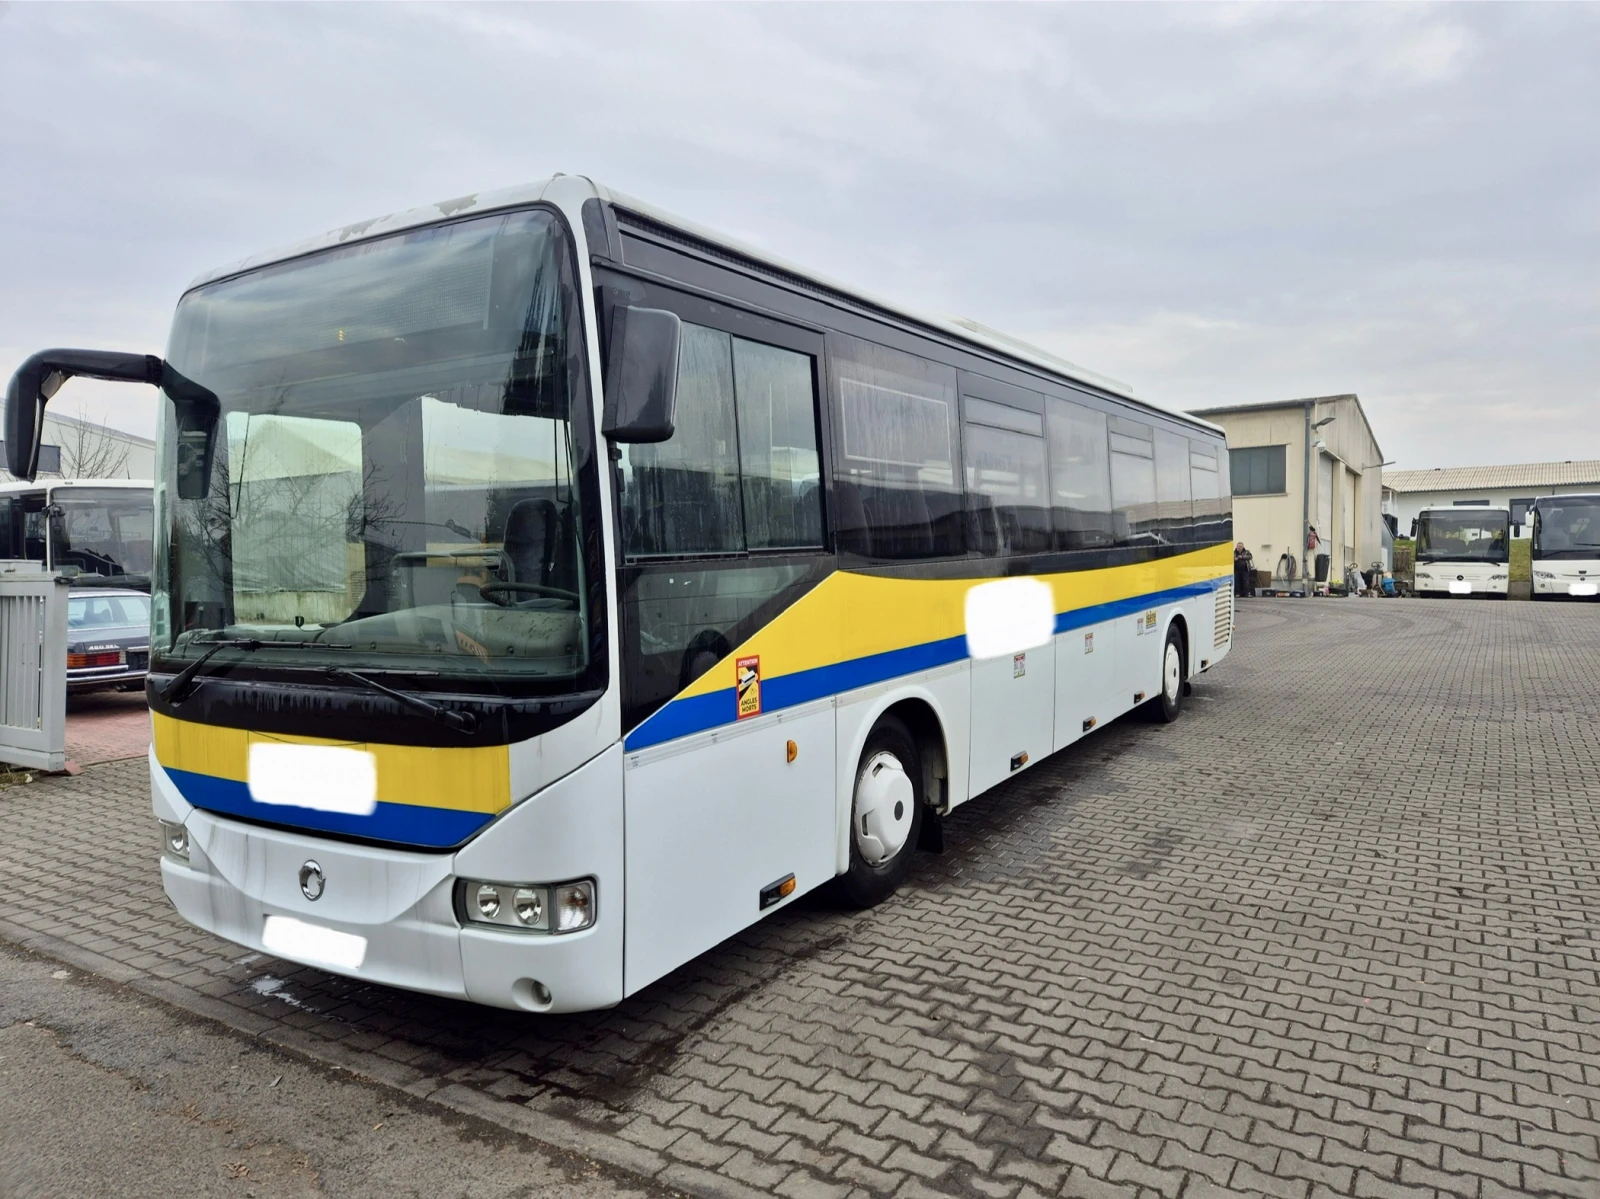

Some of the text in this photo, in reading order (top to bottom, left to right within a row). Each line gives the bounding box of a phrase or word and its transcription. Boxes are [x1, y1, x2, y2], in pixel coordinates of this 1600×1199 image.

[738, 658, 758, 667] ATTENTION
[741, 697, 757, 706] ANGLES
[741, 704, 757, 713] MORTS
